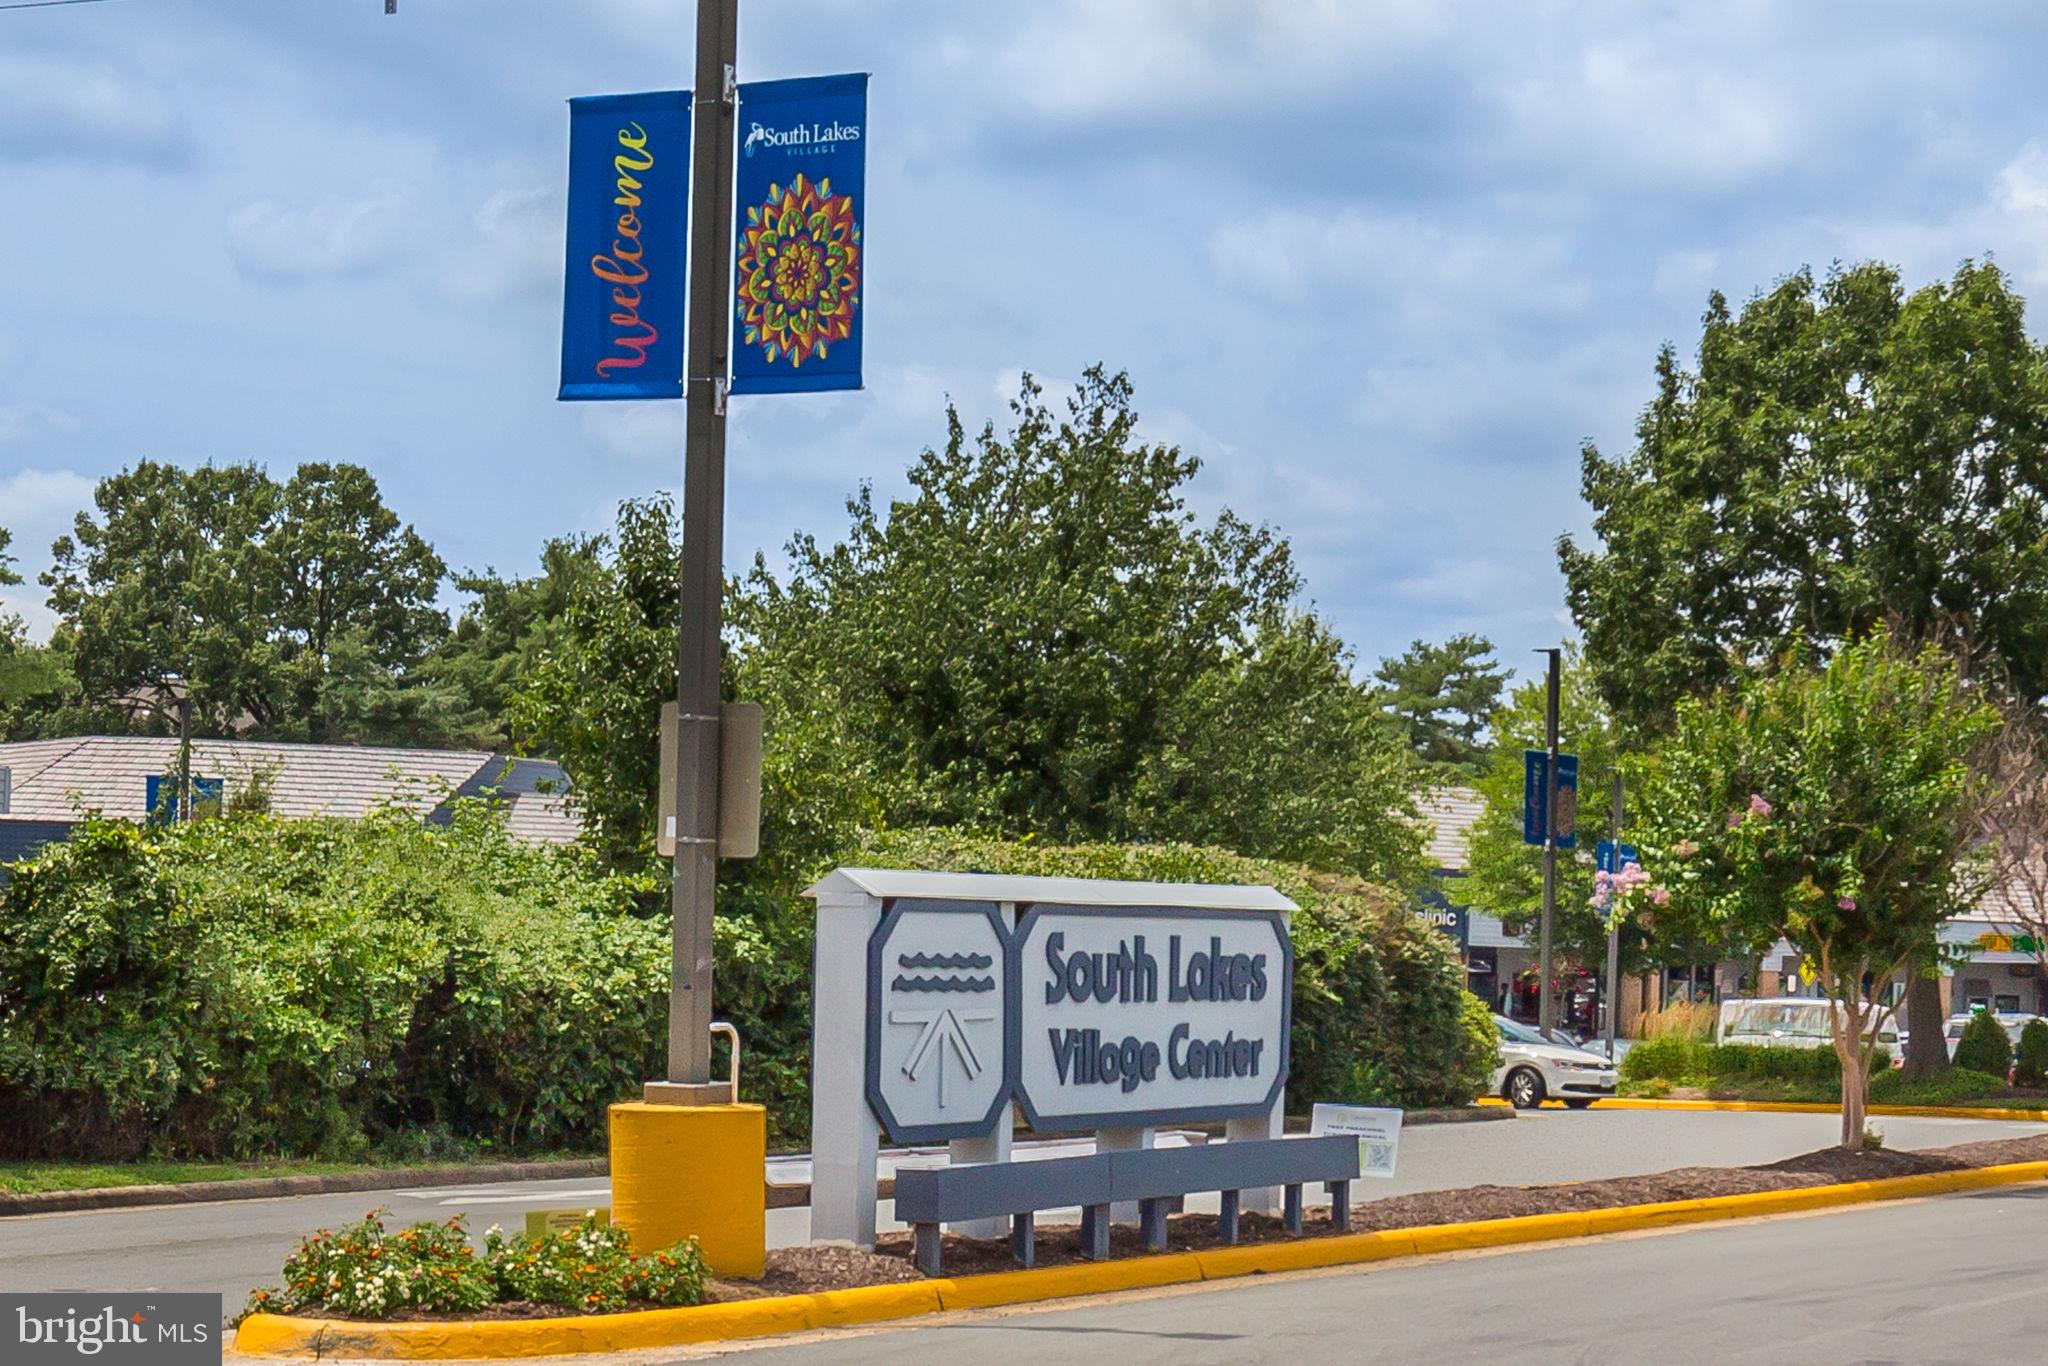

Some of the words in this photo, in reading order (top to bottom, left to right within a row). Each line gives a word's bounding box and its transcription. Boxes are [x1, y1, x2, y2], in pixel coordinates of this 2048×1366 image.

[764, 123, 810, 147] South
[813, 120, 860, 144] Lakes
[787, 144, 835, 156] VILLAGE
[1045, 931, 1158, 1005] South
[1168, 934, 1268, 1003] Lakes
[1048, 1026, 1161, 1094] Village
[1168, 1022, 1264, 1081] Center
